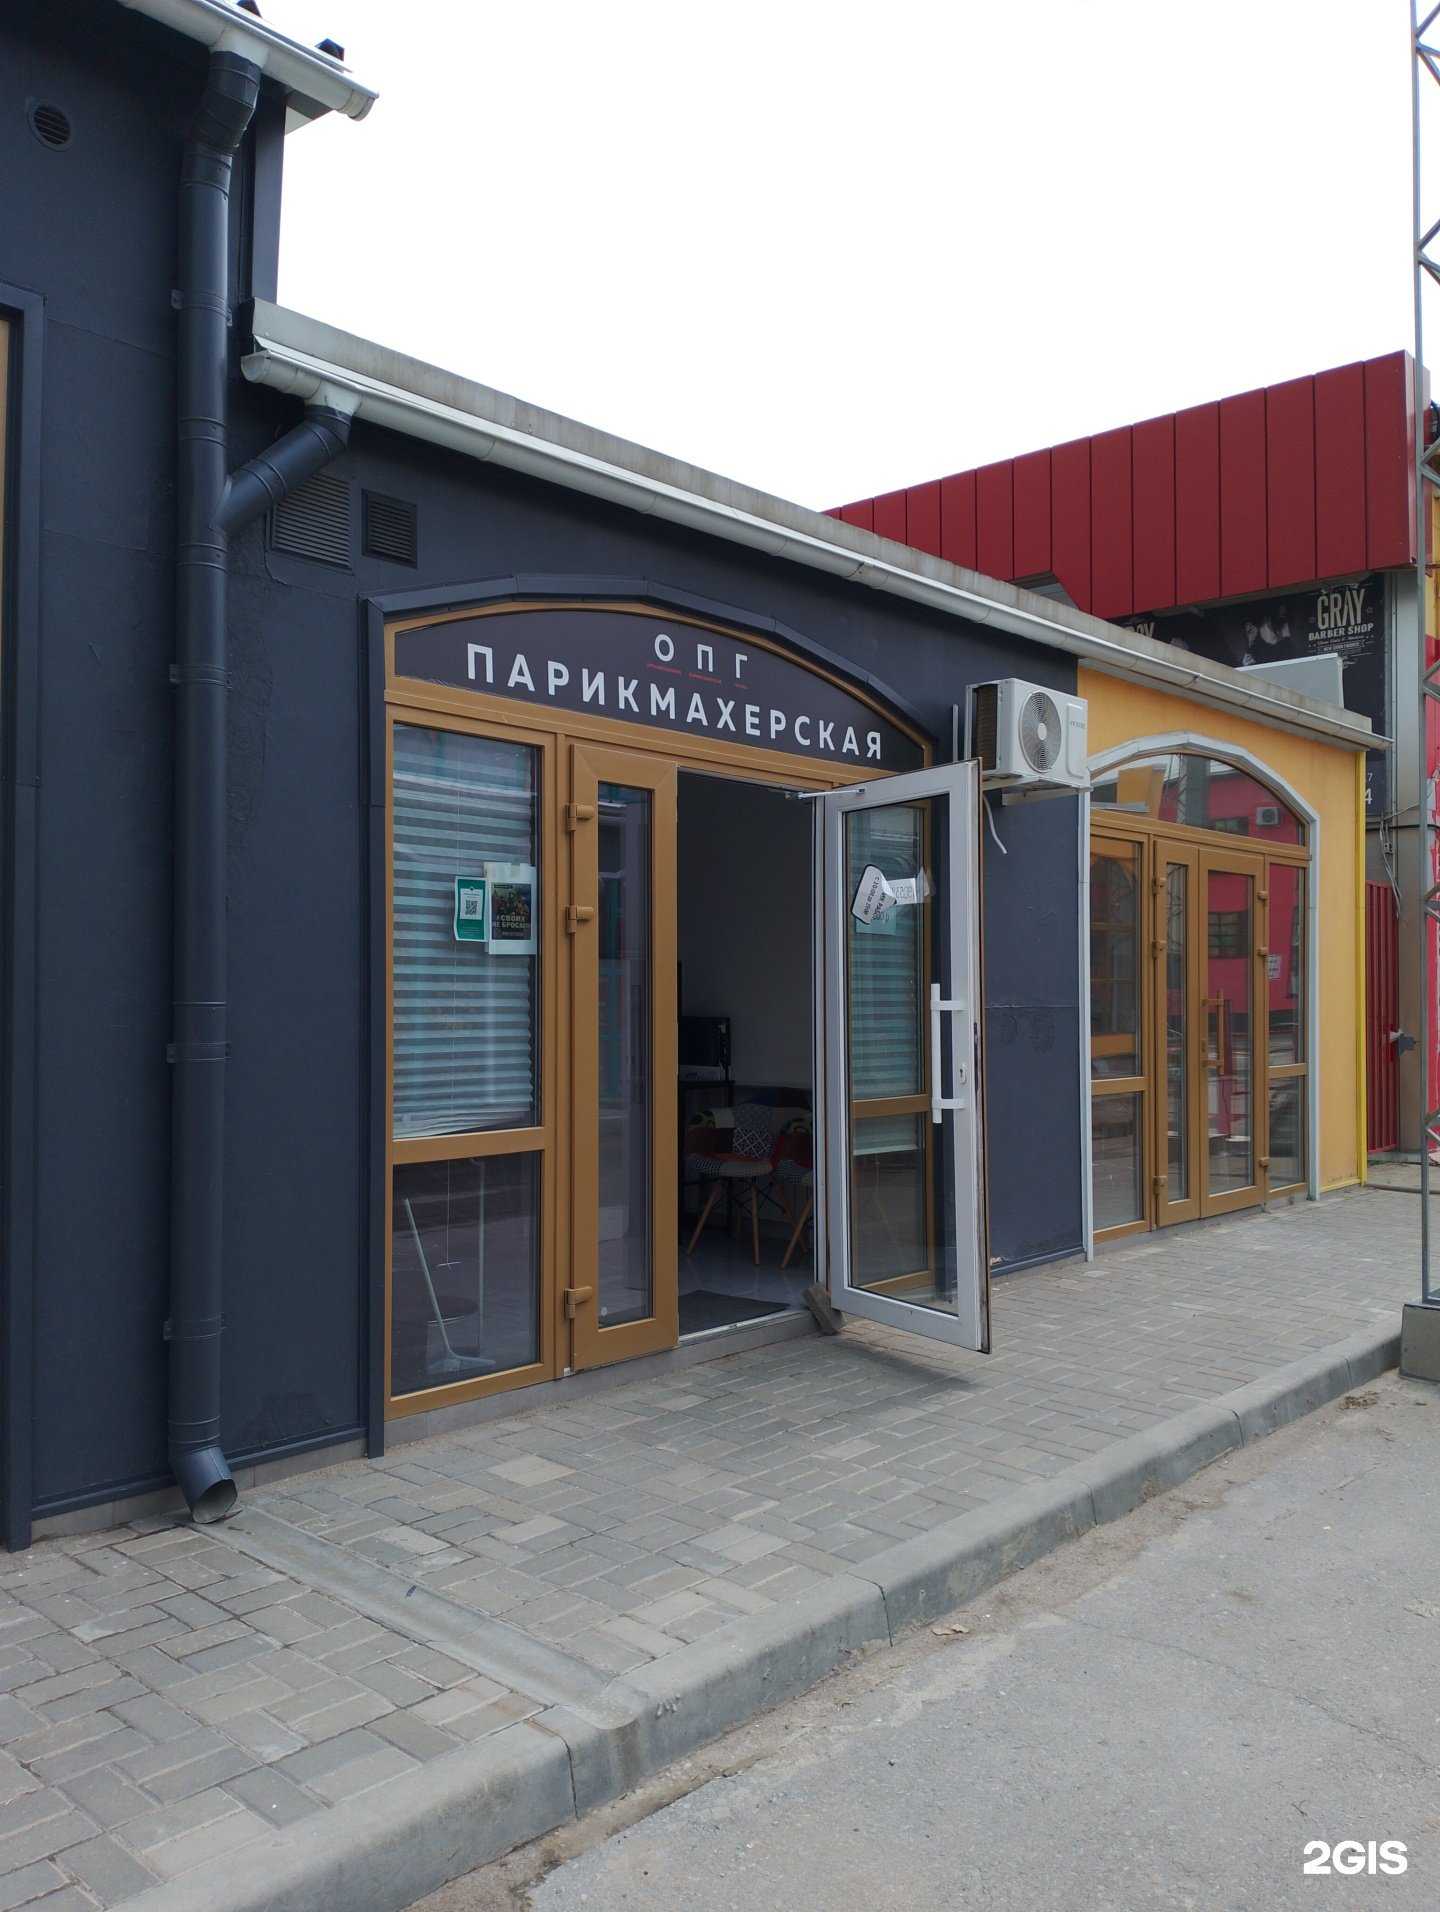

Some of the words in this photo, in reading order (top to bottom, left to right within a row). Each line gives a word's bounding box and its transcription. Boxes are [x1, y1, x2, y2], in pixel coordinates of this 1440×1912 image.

[1317, 589, 1365, 630] GRAY
[1308, 627, 1345, 641] BARBER
[1347, 622, 1374, 635] SHOP
[467, 643, 882, 760] ПАРИКМАХЕРСКАЯ
